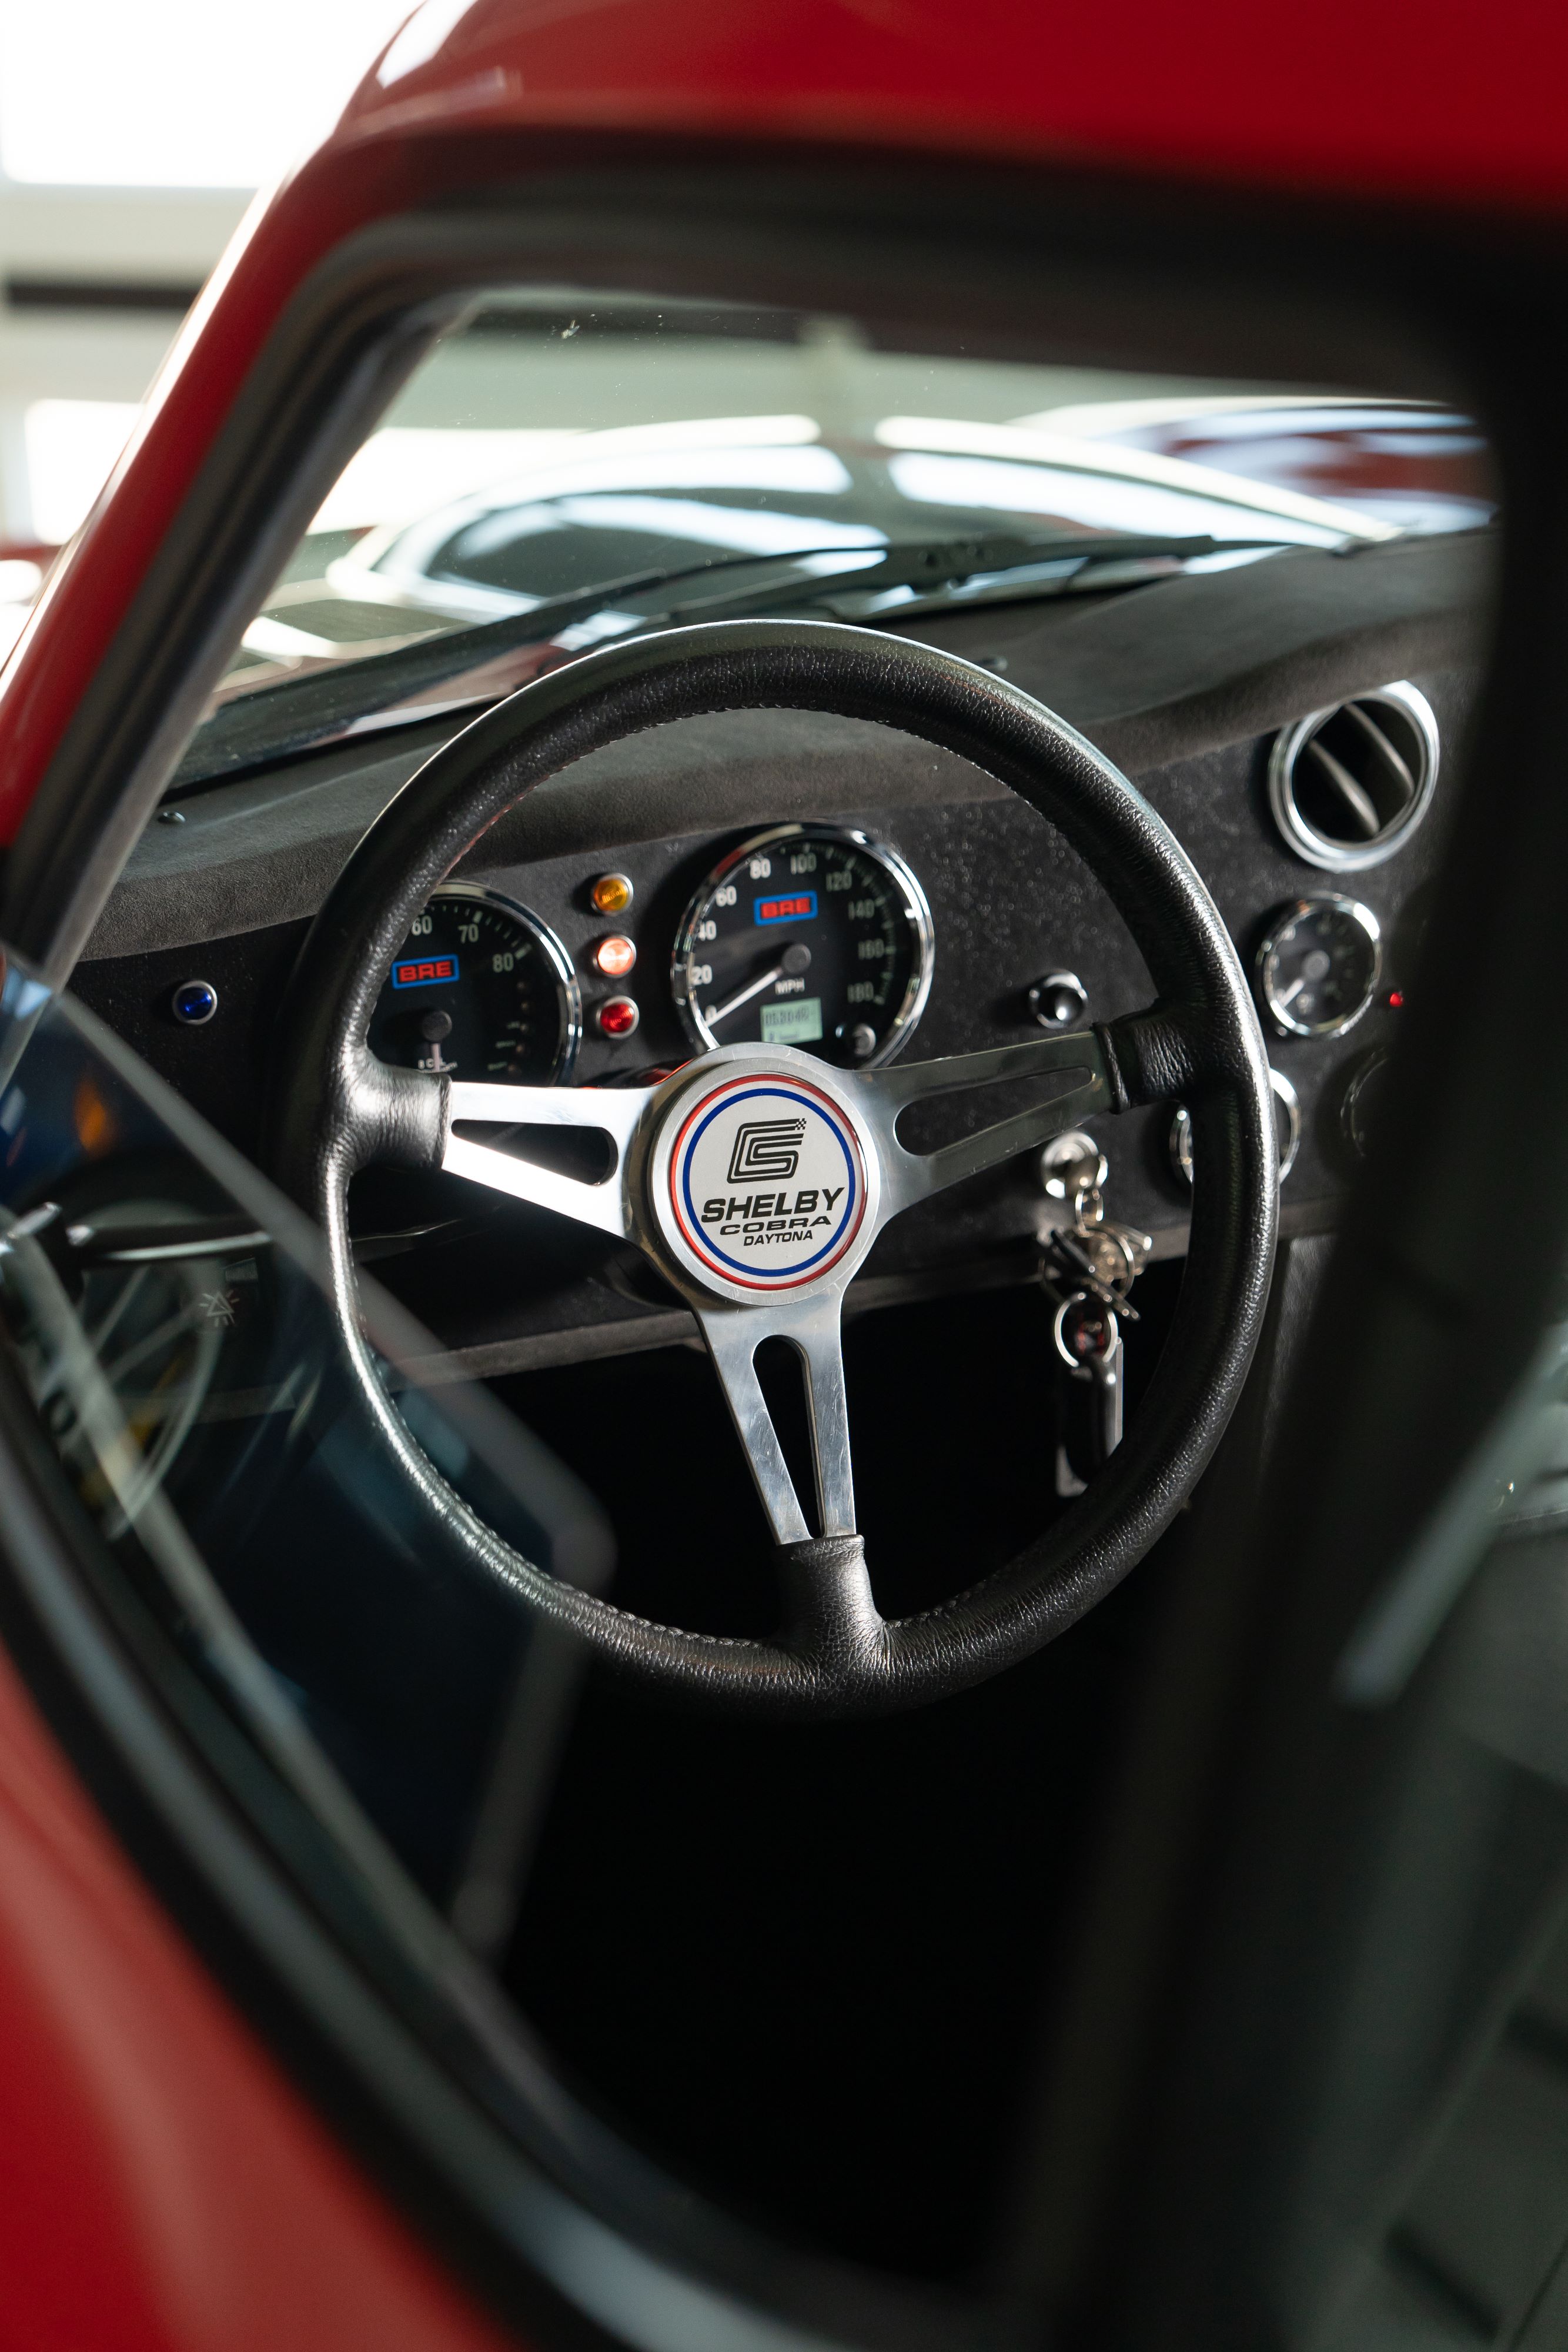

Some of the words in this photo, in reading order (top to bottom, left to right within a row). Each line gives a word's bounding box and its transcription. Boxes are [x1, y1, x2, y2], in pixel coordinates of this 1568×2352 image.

[750, 858, 771, 880] 80
[790, 853, 817, 875] 100
[826, 870, 852, 892] 120
[716, 886, 737, 907] 60
[761, 897, 811, 919] BRE
[848, 898, 875, 921] 140
[457, 923, 479, 944] 70
[399, 960, 452, 983] BRE
[493, 953, 514, 973] 80
[693, 964, 713, 986] 20
[775, 978, 805, 995] MPH
[701, 1187, 845, 1223] SHELBY
[720, 1215, 832, 1235] COBRA
[743, 1230, 813, 1247] DAYTONA
